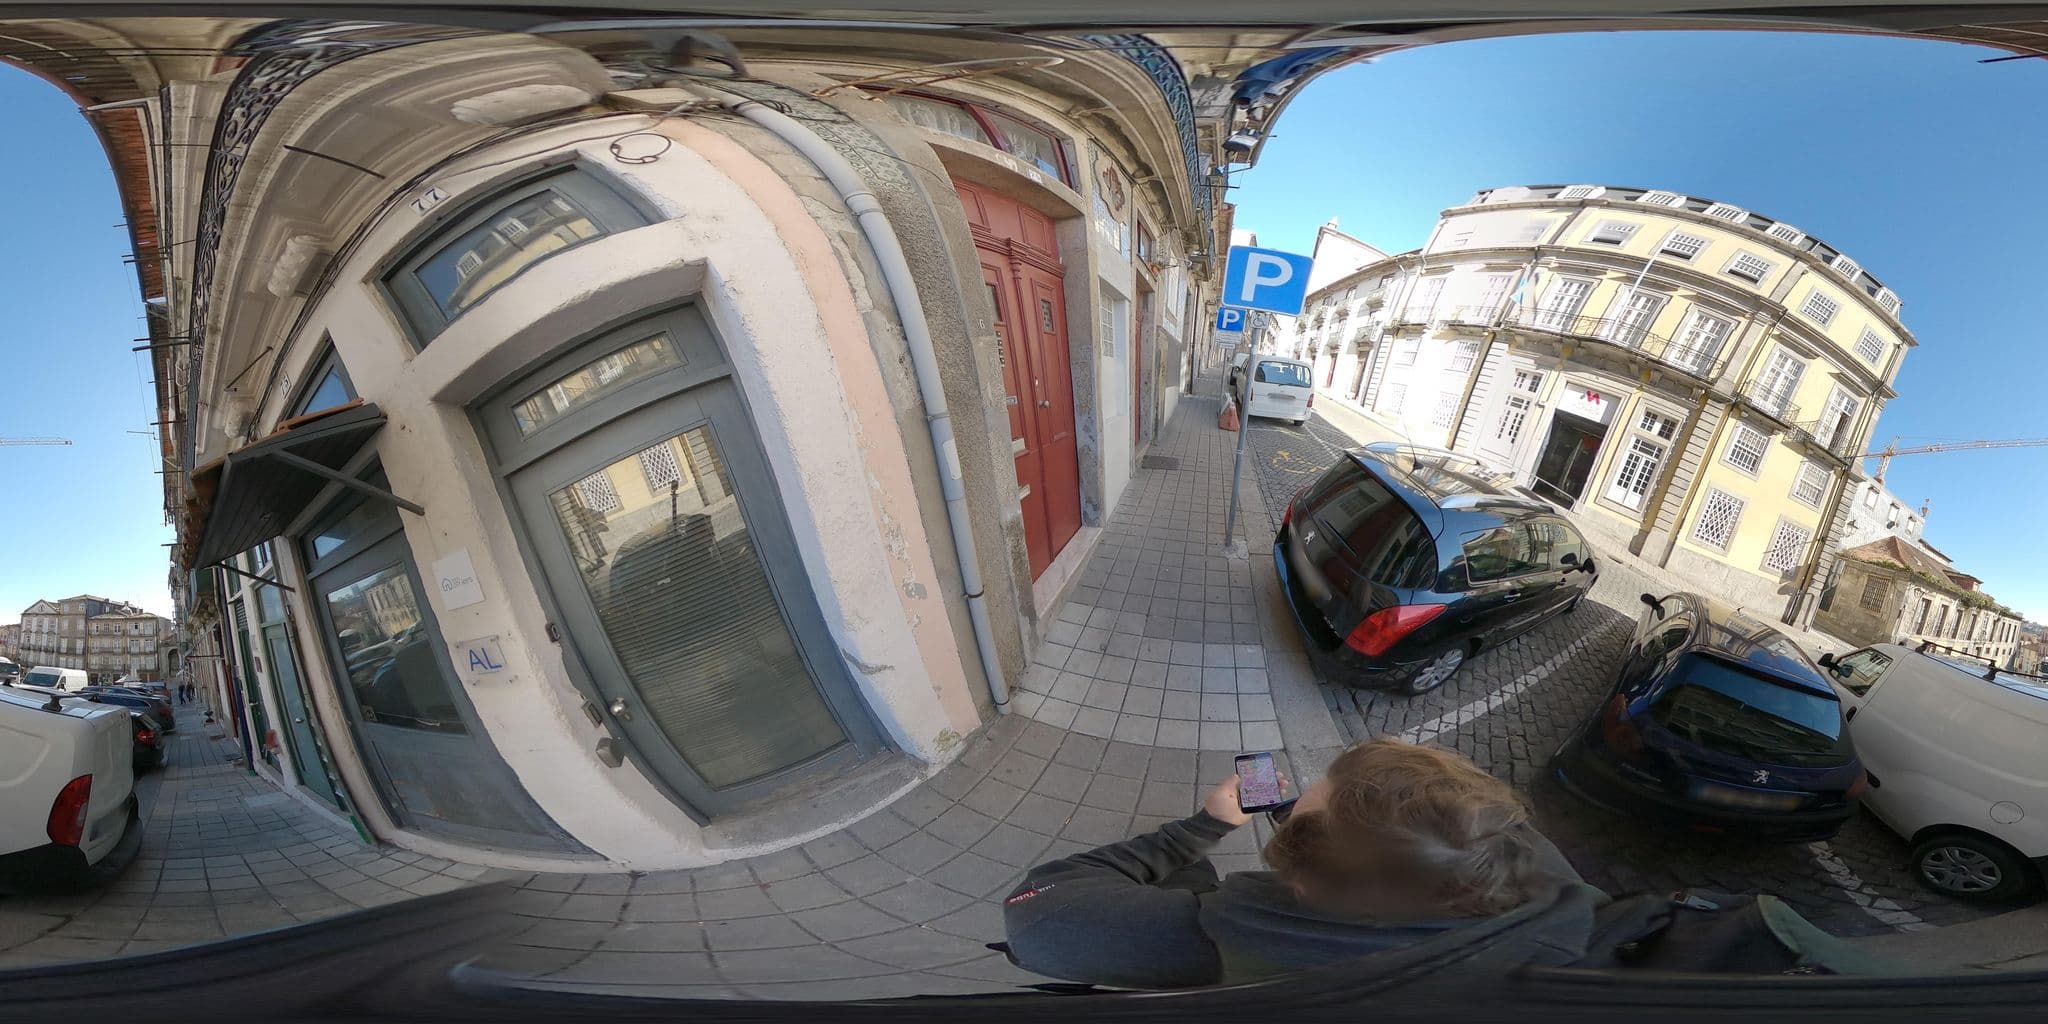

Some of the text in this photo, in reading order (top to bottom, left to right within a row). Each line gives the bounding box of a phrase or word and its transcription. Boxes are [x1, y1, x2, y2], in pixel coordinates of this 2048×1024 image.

[410, 188, 440, 211] 77
[1241, 252, 1293, 302] P
[1221, 309, 1241, 329] P
[469, 647, 503, 672] AL
